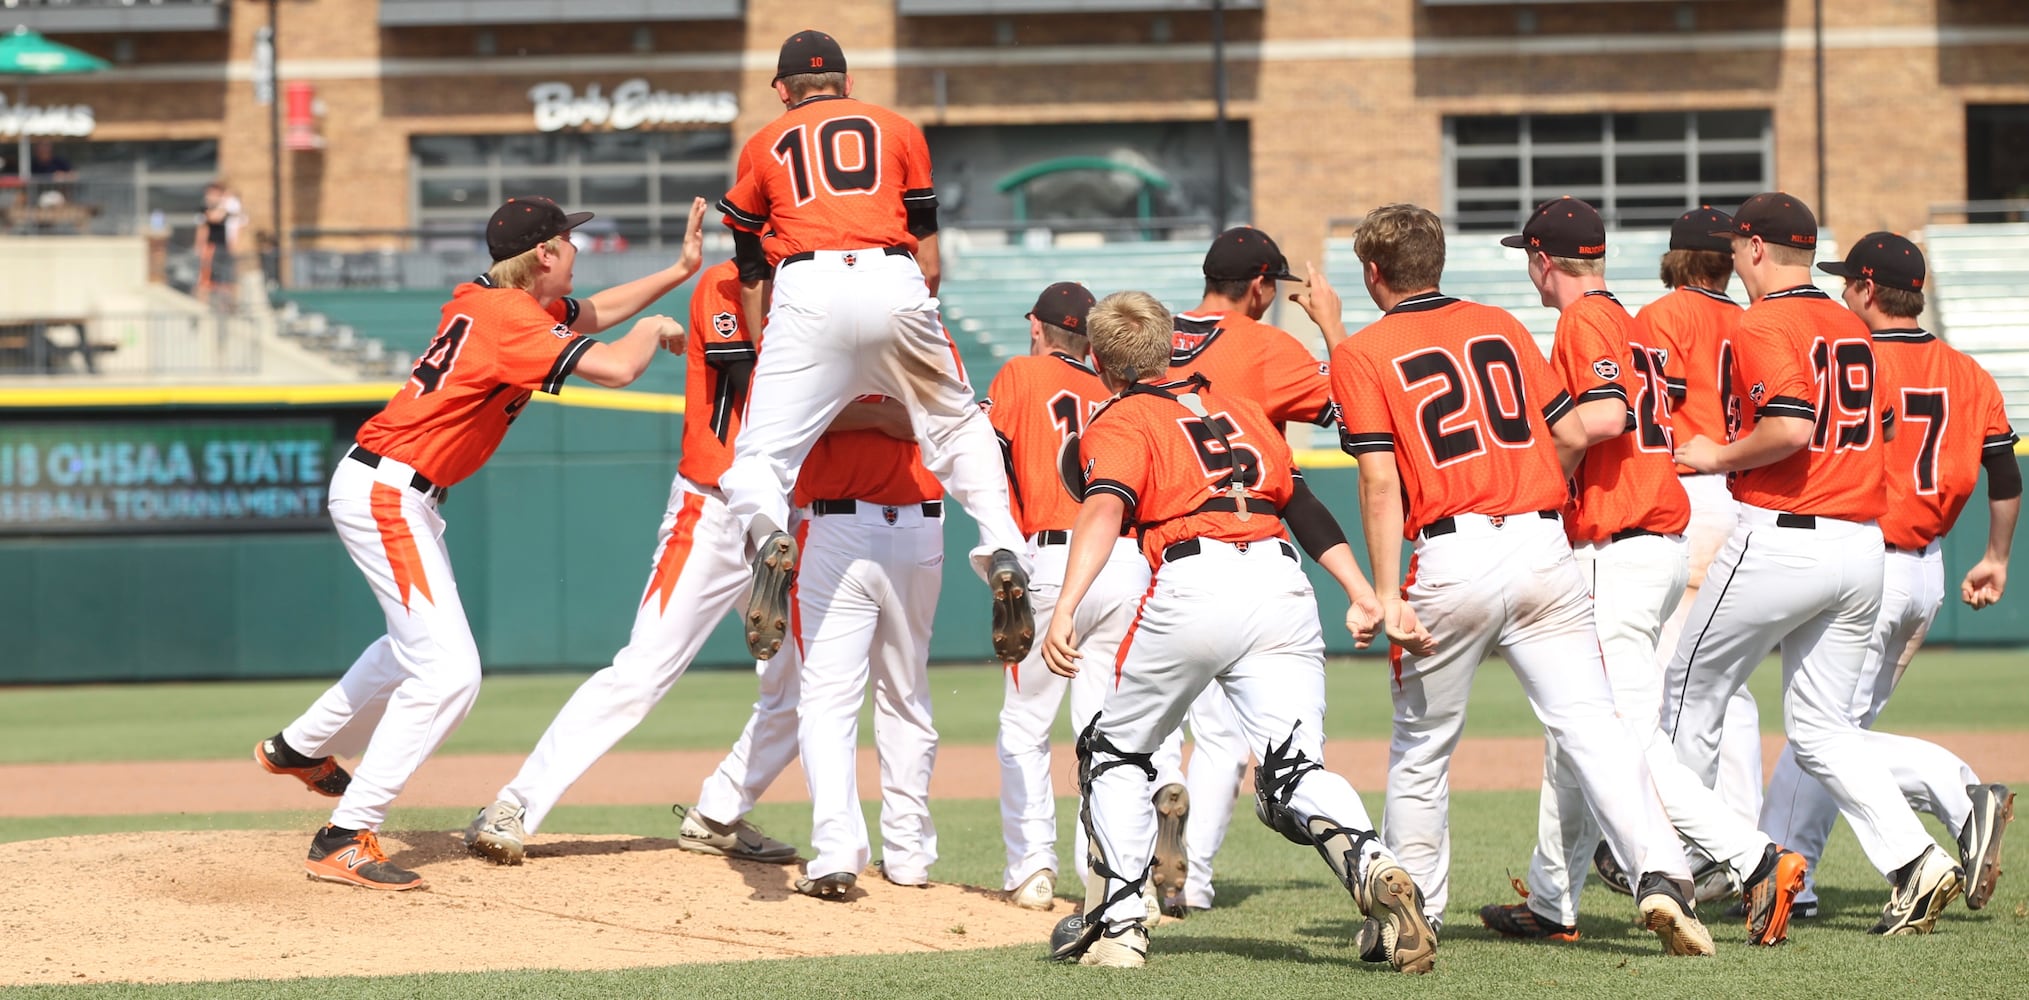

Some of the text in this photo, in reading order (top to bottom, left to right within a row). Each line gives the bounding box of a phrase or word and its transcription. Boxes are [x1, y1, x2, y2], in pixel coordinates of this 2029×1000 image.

[810, 56, 823, 68] 10
[0, 92, 95, 137] vans
[529, 79, 739, 132] Bob Evans
[770, 115, 882, 208] 10
[1063, 315, 1079, 328] 23
[1391, 334, 1535, 469] 20
[1809, 336, 1876, 454] 19
[46, 442, 196, 487] OHSAA
[202, 439, 325, 485] STATE
[1177, 411, 1266, 494] 5
[1900, 387, 1949, 495] 7
[110, 486, 326, 518] TOURNAMENT
